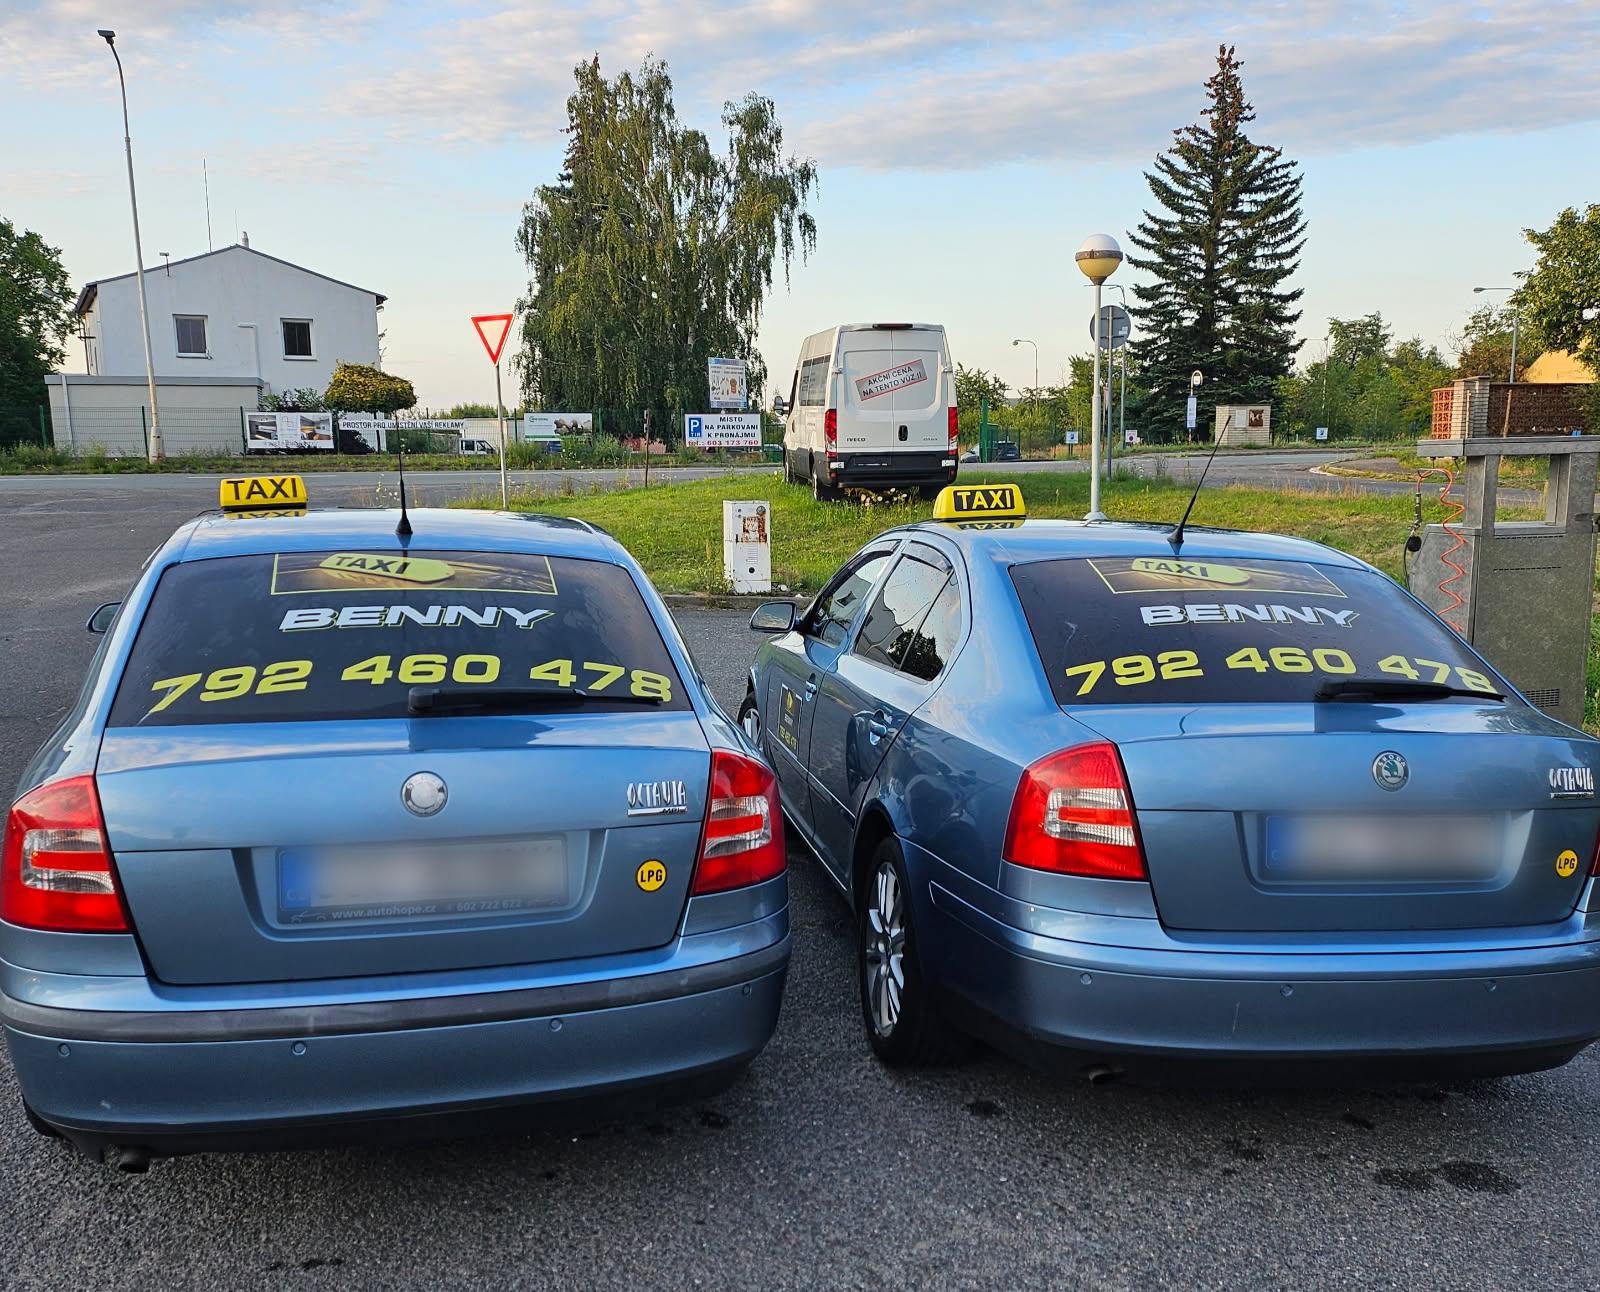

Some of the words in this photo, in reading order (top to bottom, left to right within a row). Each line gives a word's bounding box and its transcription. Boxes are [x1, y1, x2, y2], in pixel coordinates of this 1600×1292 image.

[891, 366, 913, 378] CENA
[862, 388, 875, 397] NA
[875, 380, 900, 392] TENTO
[342, 421, 372, 429] PROSTOR
[373, 421, 386, 429] PRO
[387, 420, 418, 429] UMSTĚNÍ
[434, 421, 465, 429] REKLAMY
[226, 477, 298, 500] TAXI
[957, 490, 1012, 510] TAXI
[335, 556, 411, 574] TAXI
[1140, 560, 1209, 578] TAXI
[279, 605, 555, 632] BENNY
[1140, 604, 1360, 627] BENNY
[1065, 650, 1204, 696] 792
[1225, 647, 1357, 674] 460
[1377, 655, 1498, 694] 478
[149, 660, 313, 714] 792
[341, 654, 500, 684] 460
[529, 659, 672, 702] 478
[1548, 768, 1594, 791] OCTAVIA
[626, 780, 687, 808] OCTAVIA
[1558, 858, 1575, 870] LPG
[640, 869, 663, 882] LPG
[331, 903, 437, 919] www.autohope.cz
